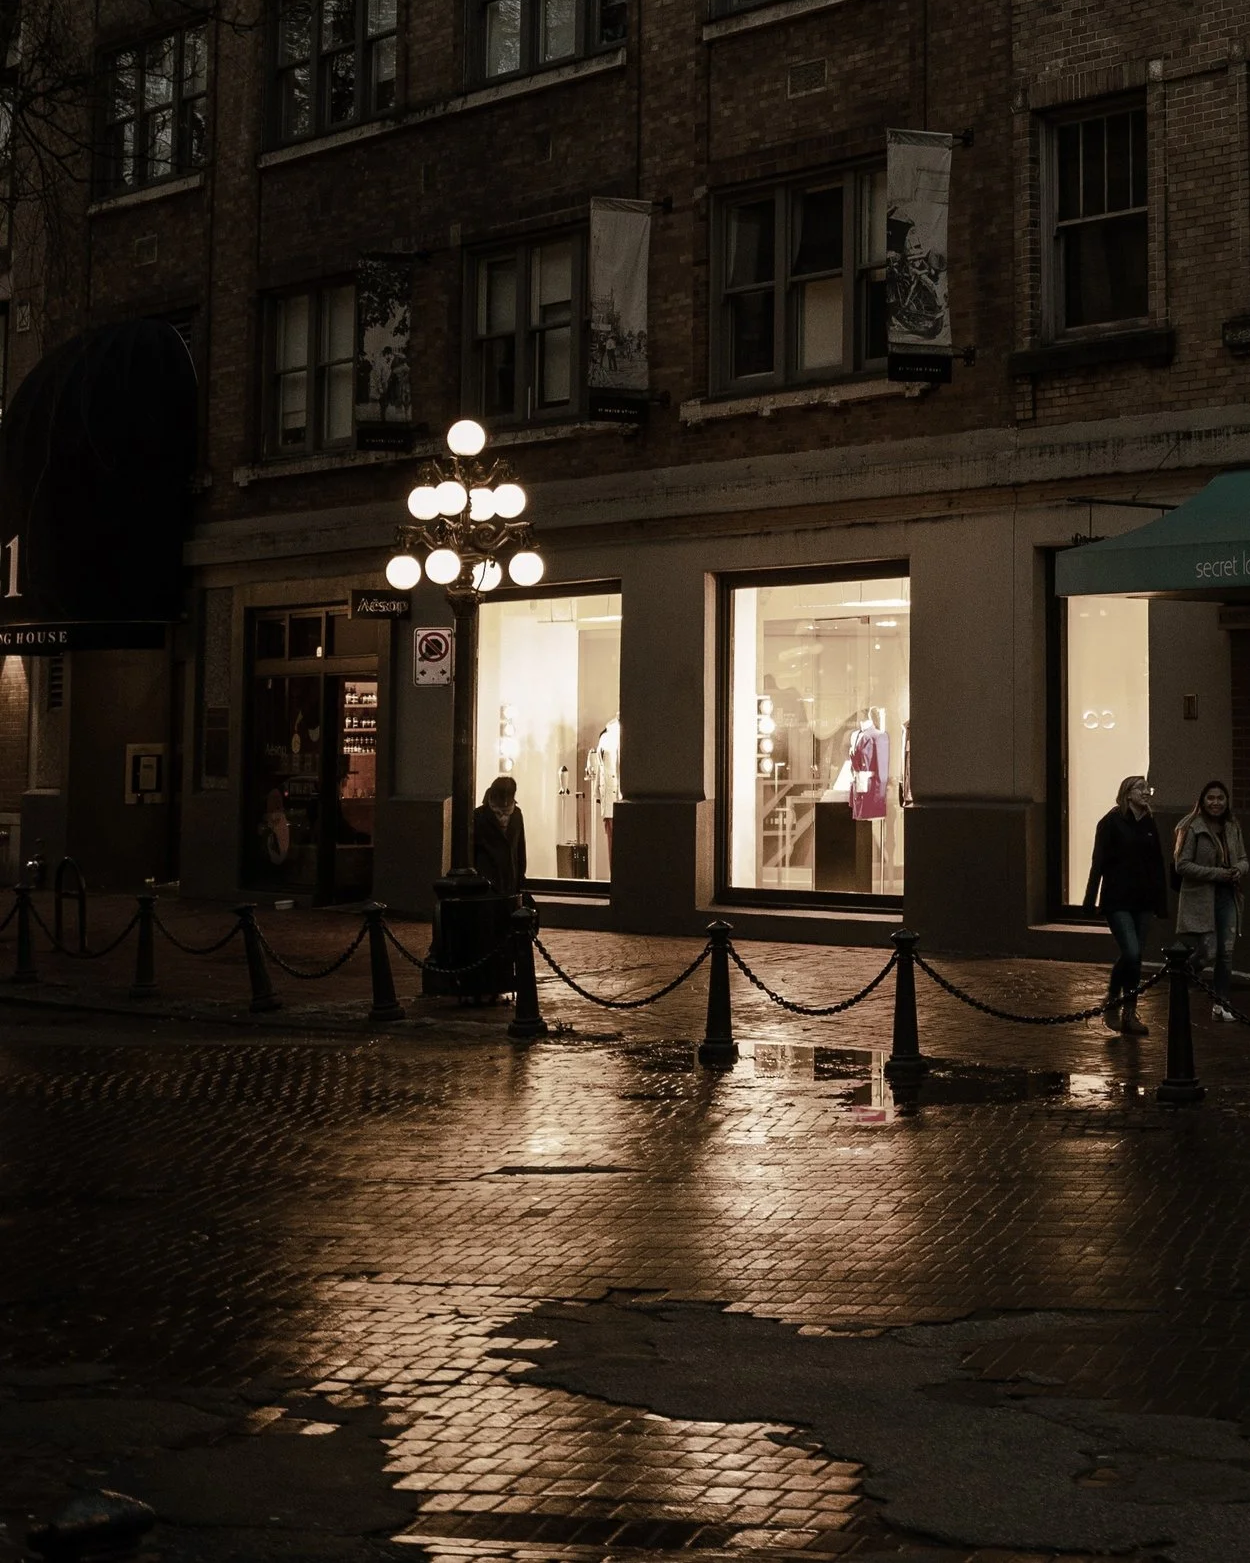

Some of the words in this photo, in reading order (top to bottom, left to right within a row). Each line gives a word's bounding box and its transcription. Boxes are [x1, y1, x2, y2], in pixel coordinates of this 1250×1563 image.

[0, 534, 23, 598] 1
[1195, 557, 1238, 578] secret
[16, 631, 68, 644] HOUSE
